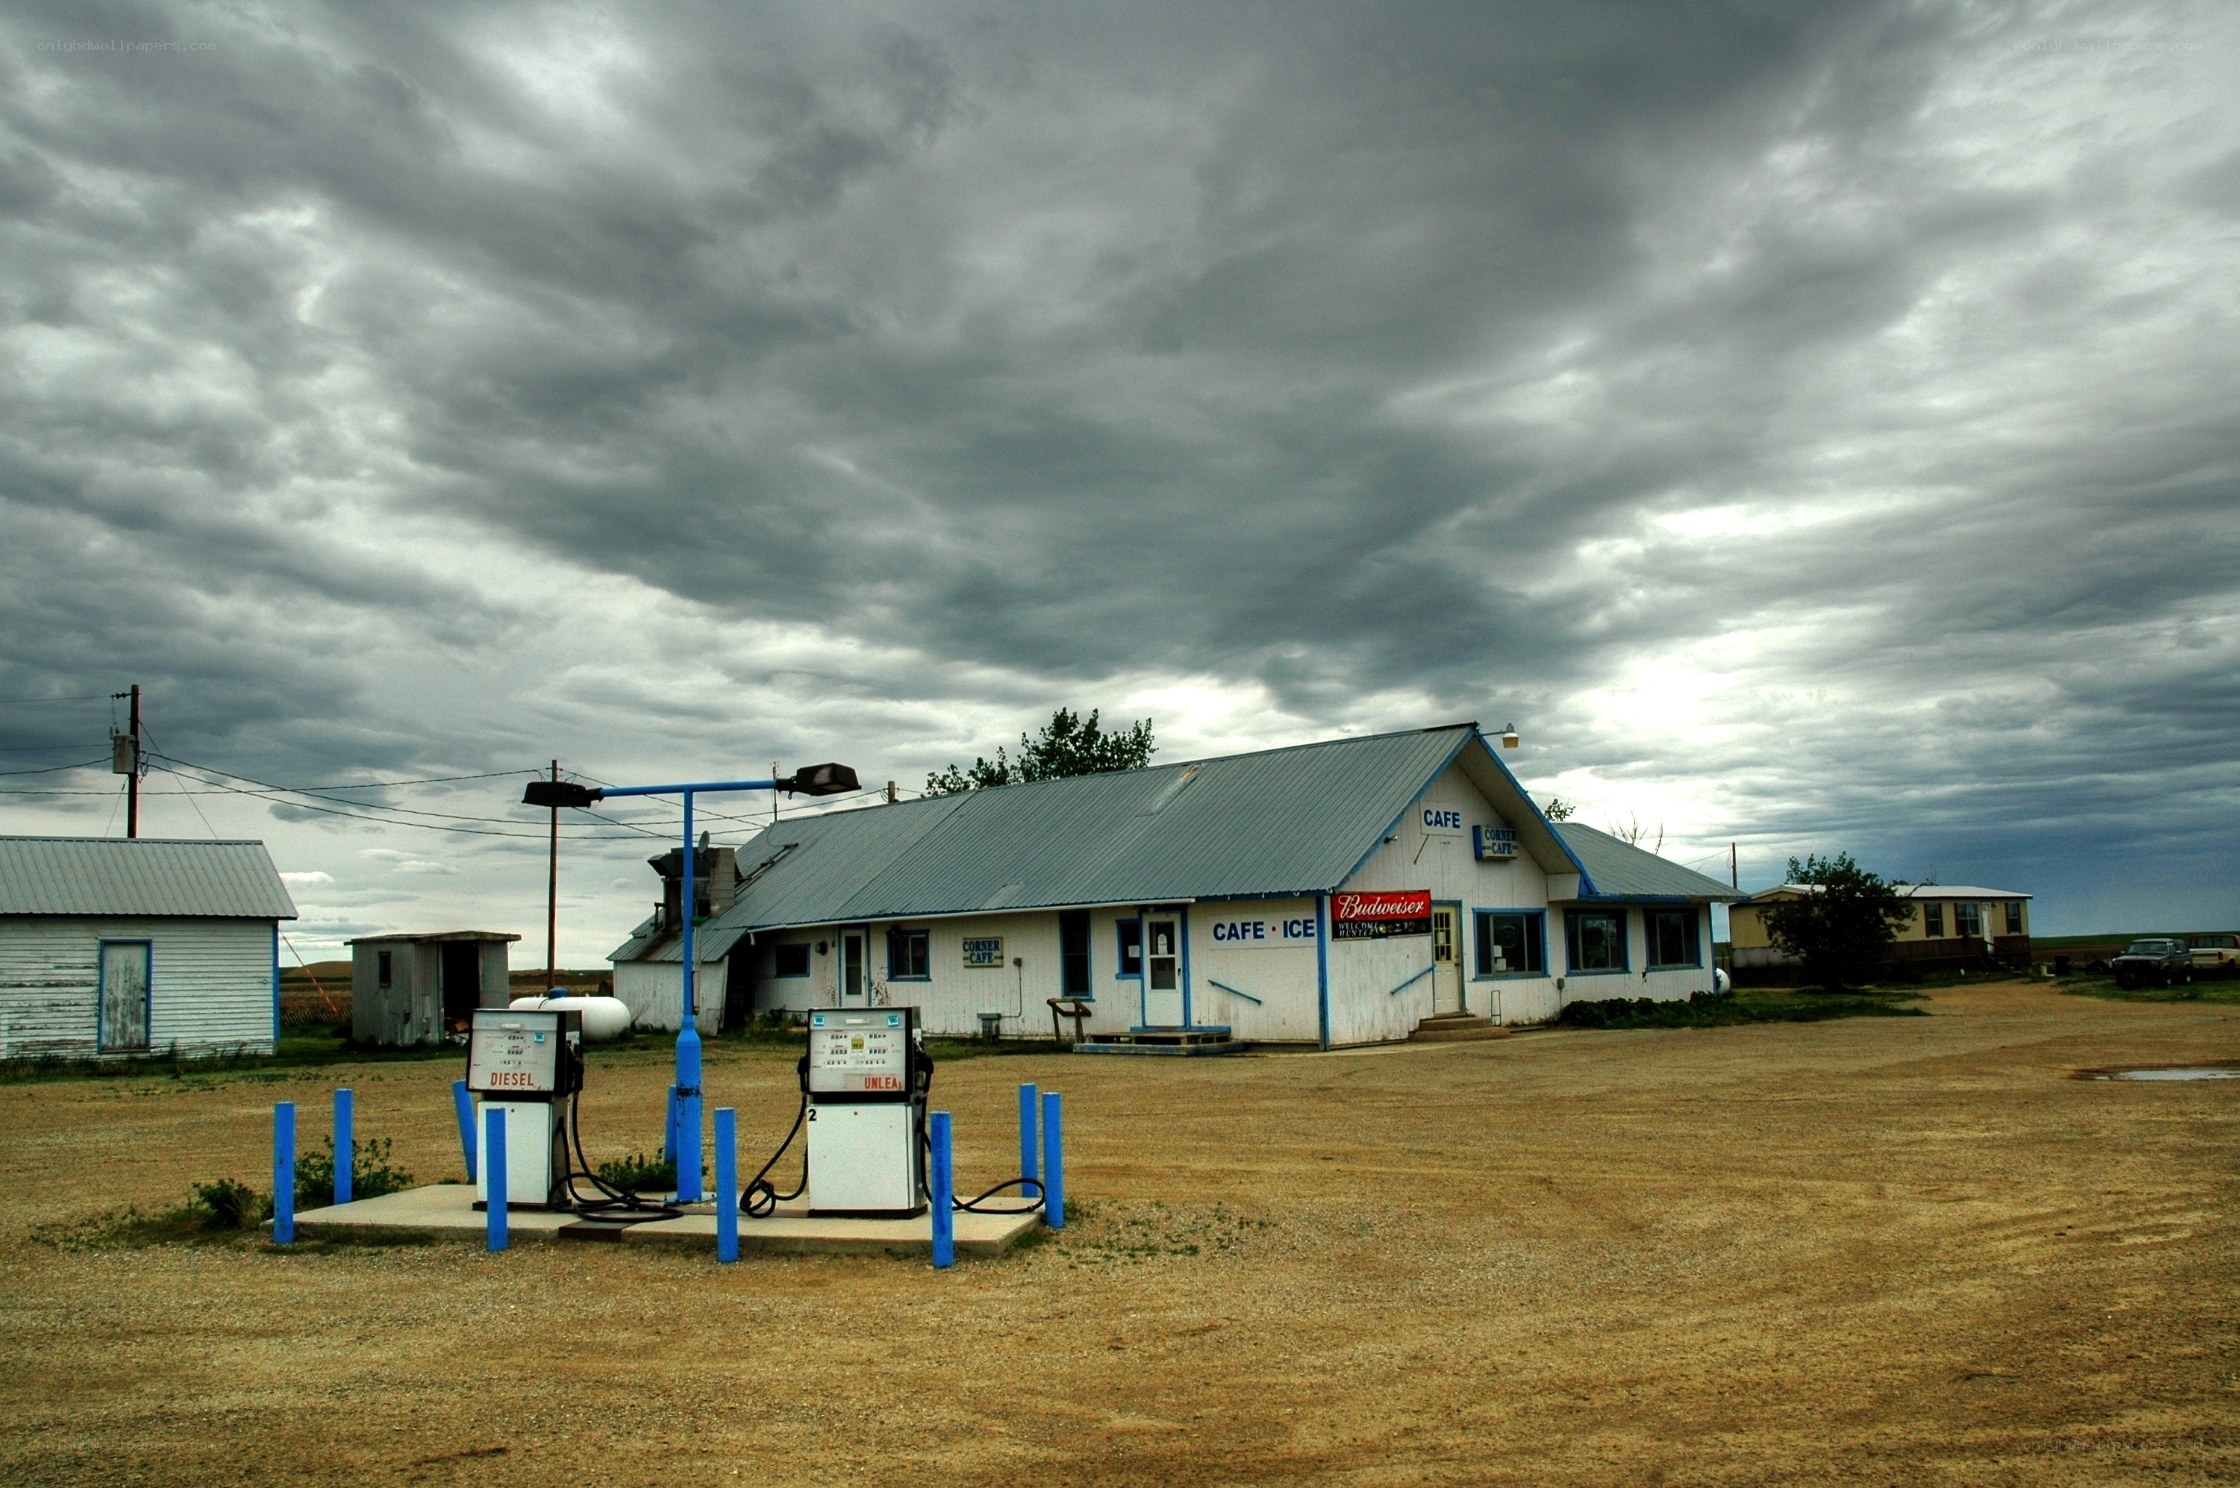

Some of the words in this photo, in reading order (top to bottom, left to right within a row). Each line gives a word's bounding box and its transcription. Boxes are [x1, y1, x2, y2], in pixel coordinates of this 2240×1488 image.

[1423, 809, 1461, 829] CAFE
[1484, 828, 1517, 842] CORNER
[1491, 843, 1513, 855] CAFE
[1338, 894, 1425, 919] Budweiser
[1213, 920, 1265, 942] CAFE
[1282, 919, 1315, 938] ICE
[1338, 921, 1378, 930] WELCOME
[1339, 928, 1379, 937] HUNTERS
[963, 939, 1000, 952] CORNER
[969, 952, 994, 964] CAFE
[490, 1072, 534, 1087] DIESEL
[808, 1109, 817, 1122] 2
